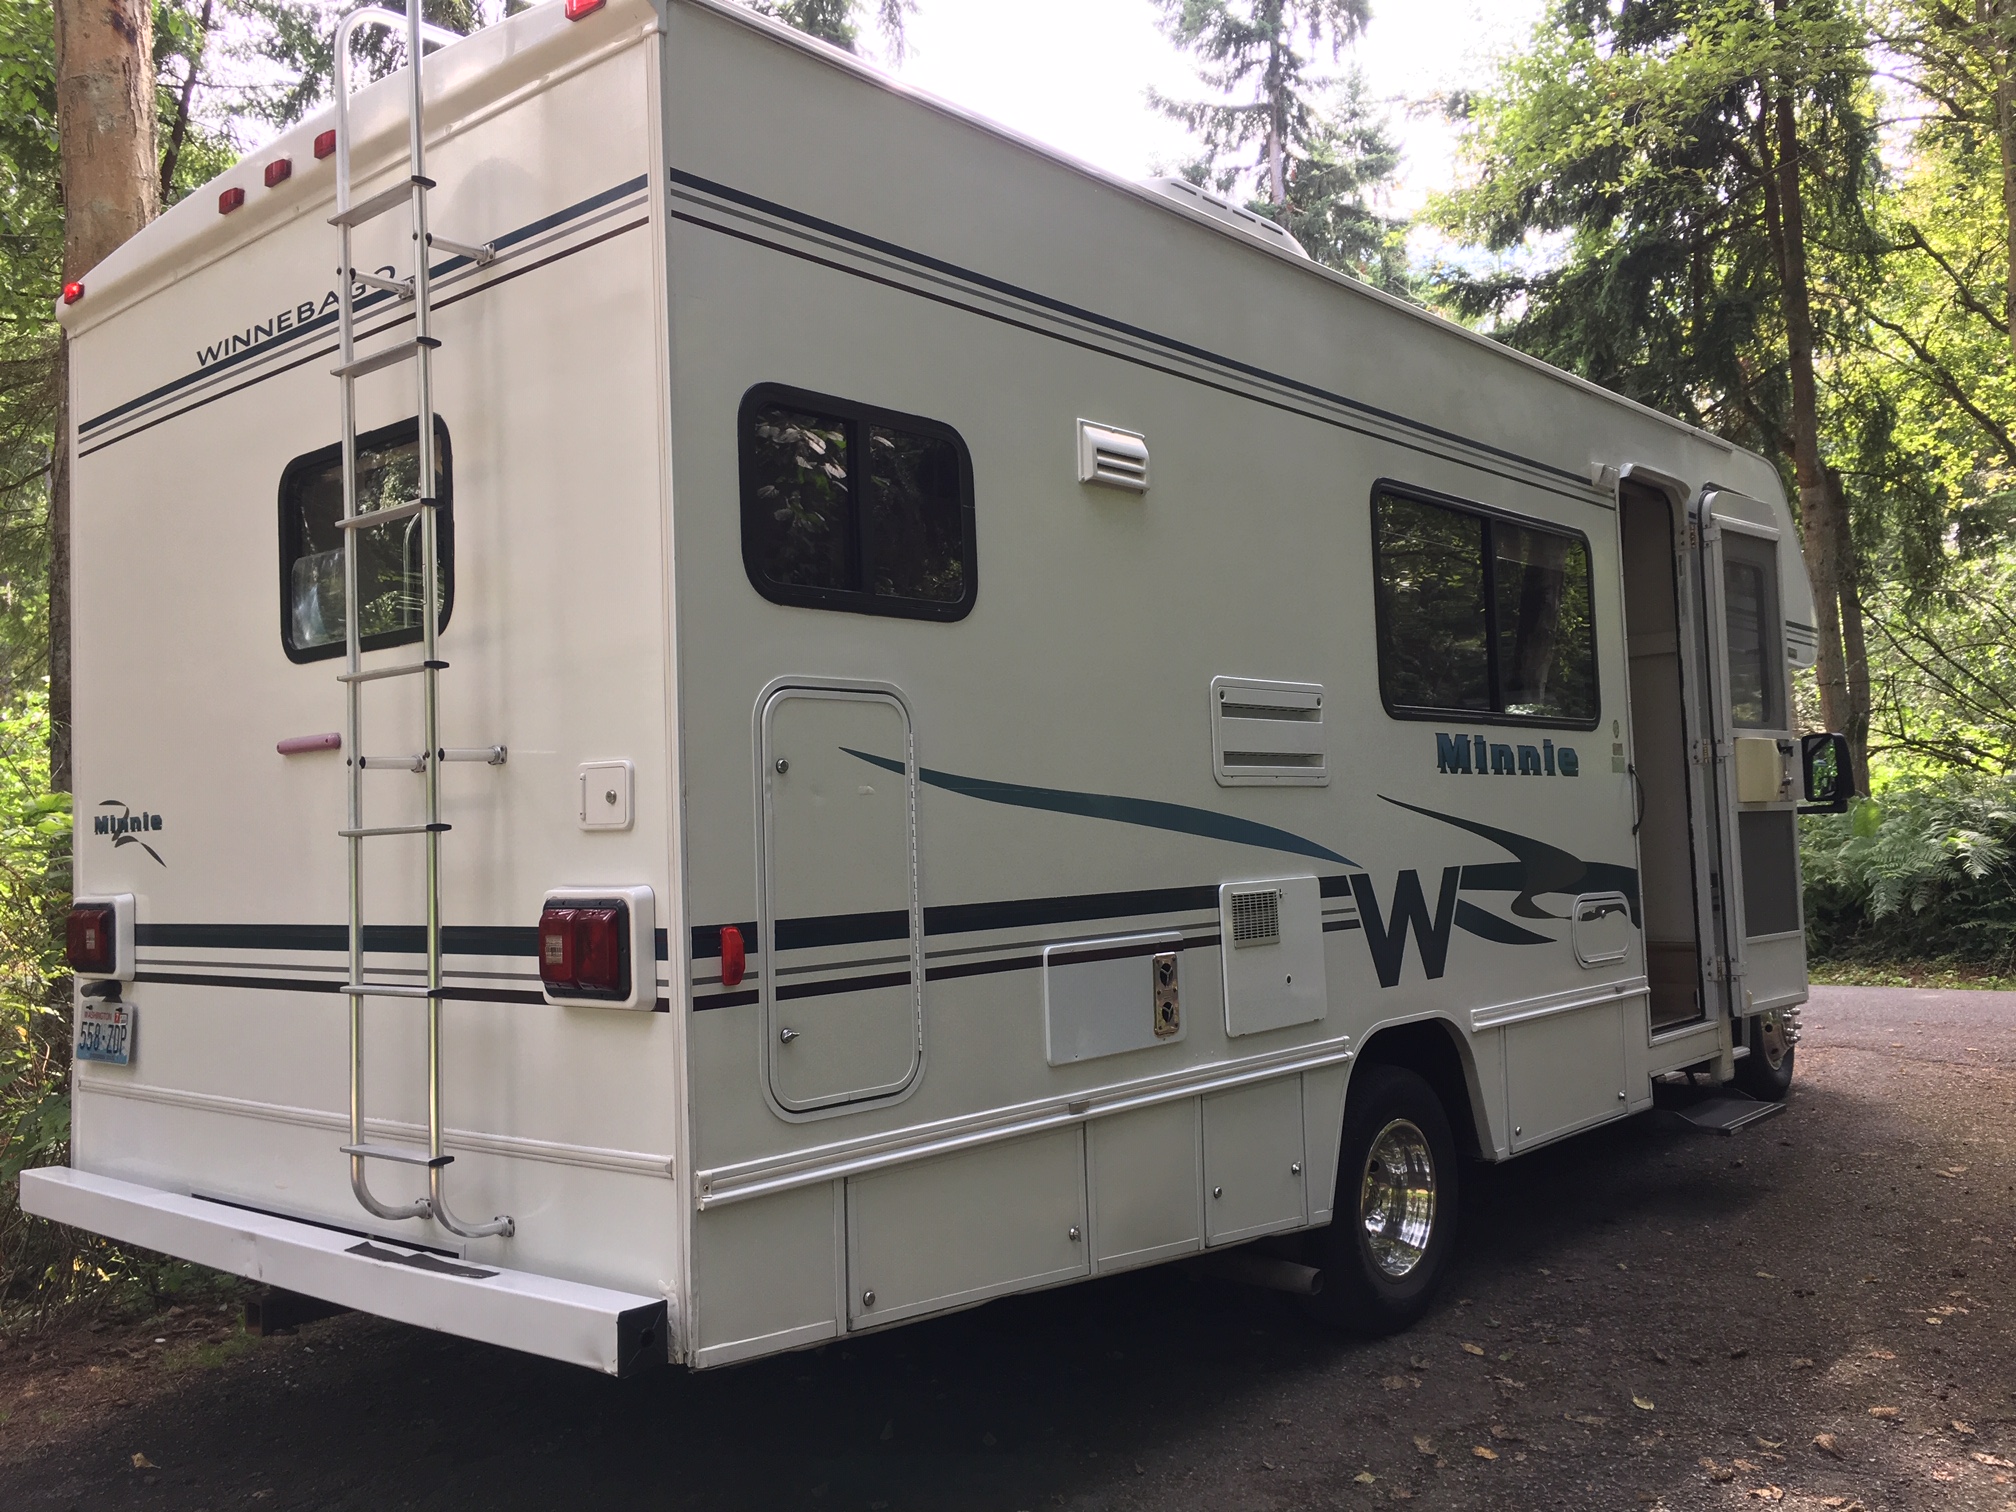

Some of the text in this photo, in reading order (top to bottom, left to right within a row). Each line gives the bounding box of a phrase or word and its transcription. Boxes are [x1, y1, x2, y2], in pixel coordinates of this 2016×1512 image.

[1435, 732, 1579, 777] Minnie
[94, 811, 163, 836] Minnie
[1349, 865, 1462, 989] W
